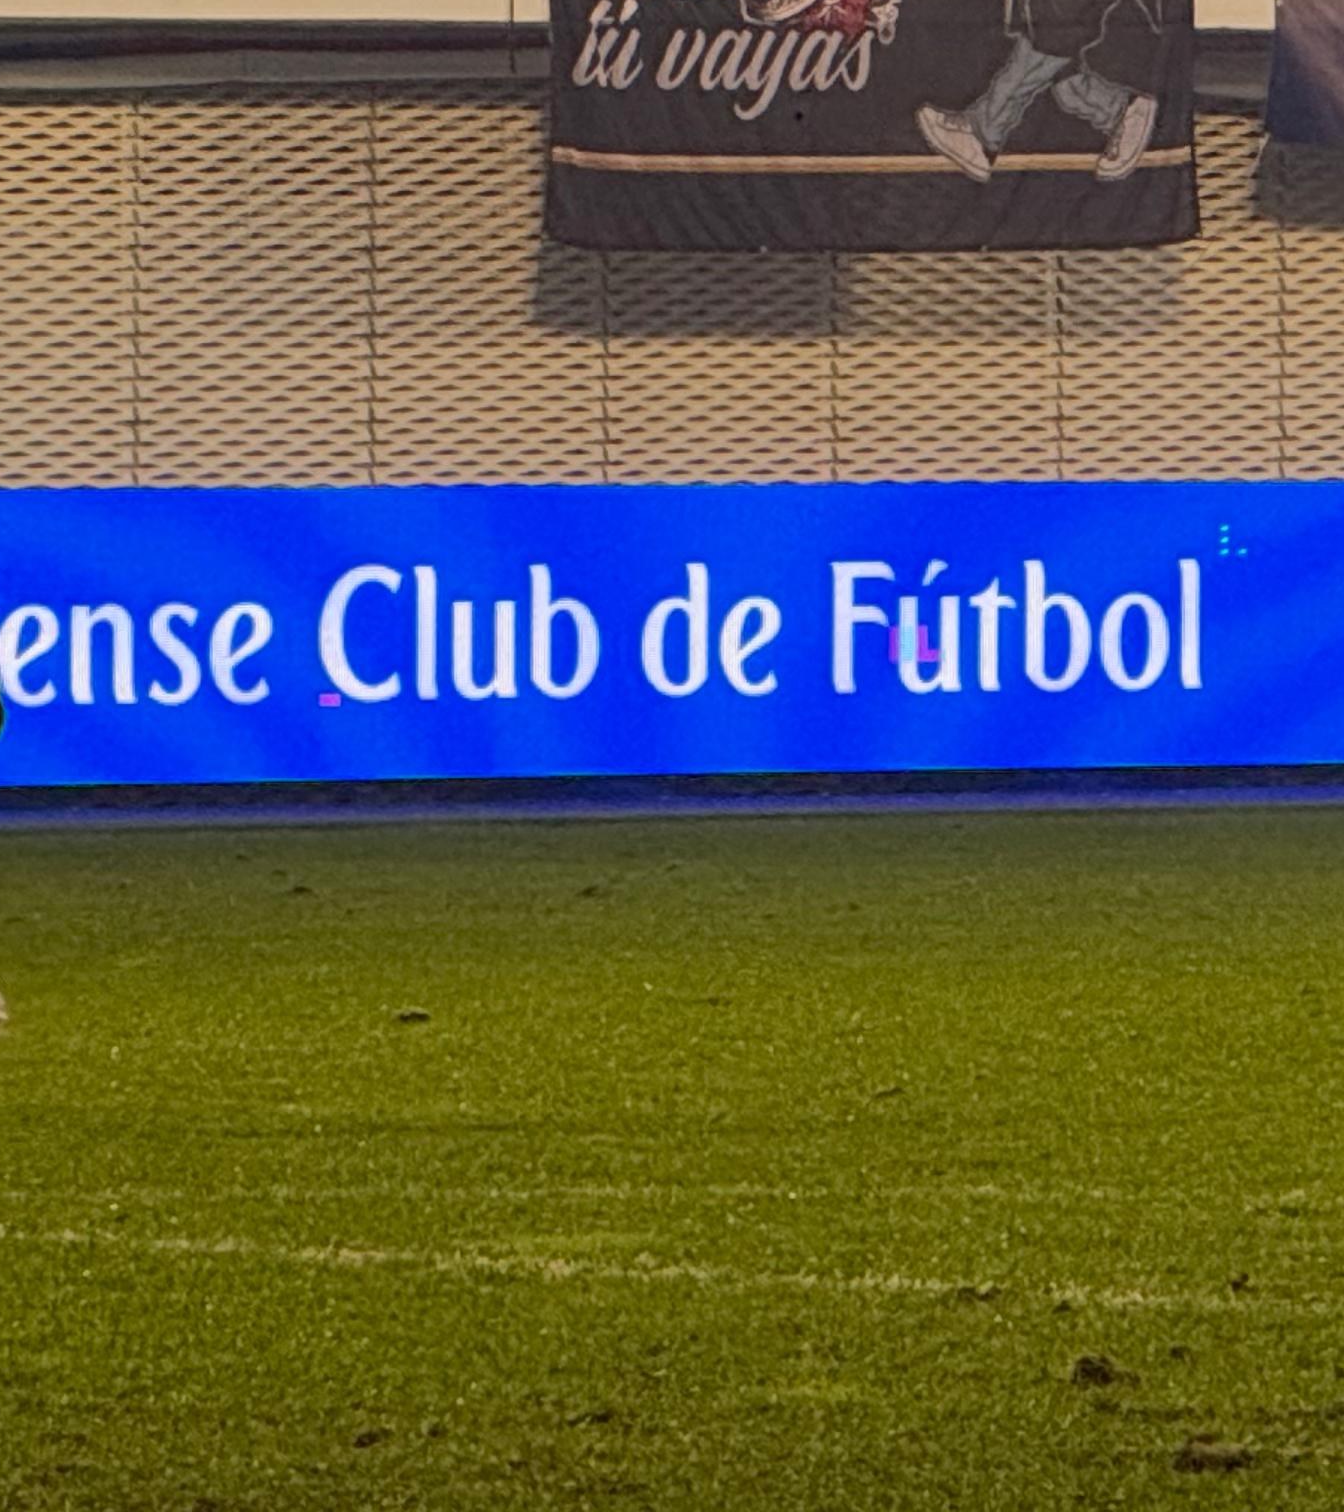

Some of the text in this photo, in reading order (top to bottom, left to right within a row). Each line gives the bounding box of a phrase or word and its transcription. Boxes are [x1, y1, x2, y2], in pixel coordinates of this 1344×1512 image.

[656, 23, 874, 120] vayas
[318, 564, 600, 702] Club
[641, 562, 782, 697] de
[830, 558, 1203, 694] Fútbol
